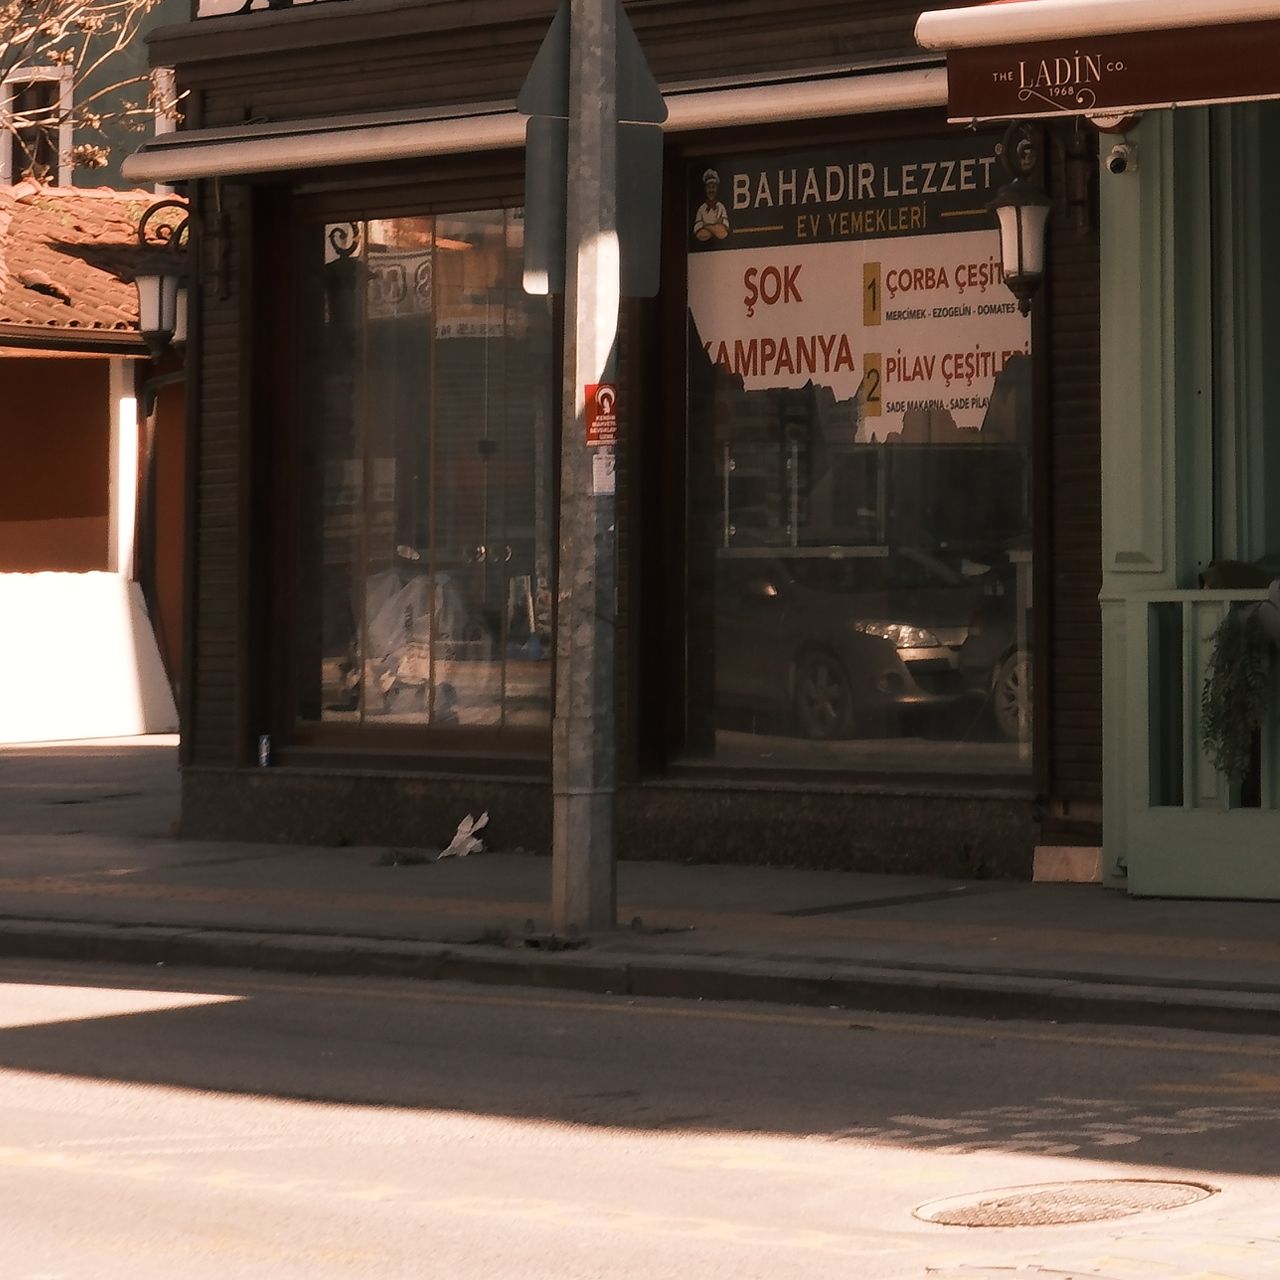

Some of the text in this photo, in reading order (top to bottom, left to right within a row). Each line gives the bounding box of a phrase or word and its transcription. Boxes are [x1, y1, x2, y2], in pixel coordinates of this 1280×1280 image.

[992, 49, 1128, 89] THE LADİN CO.
[1049, 86, 1075, 97] 1968
[732, 155, 996, 210] BAHADIR LEZZET
[797, 200, 927, 239] EV YEMEKLERİ
[743, 263, 804, 318] ŞOK
[867, 277, 877, 312] 1
[886, 256, 1004, 299] ÇORBA ÇEŞİT
[886, 306, 927, 321] MERCİMEK
[932, 303, 972, 318] EZOGELİN
[977, 302, 1016, 316] DOMATES
[703, 333, 855, 377] AMPANYA
[886, 340, 1029, 387] PİLAV ÇEŞİTLE
[866, 368, 880, 403] 2
[886, 400, 906, 413] SADE
[950, 397, 970, 410] SADE
